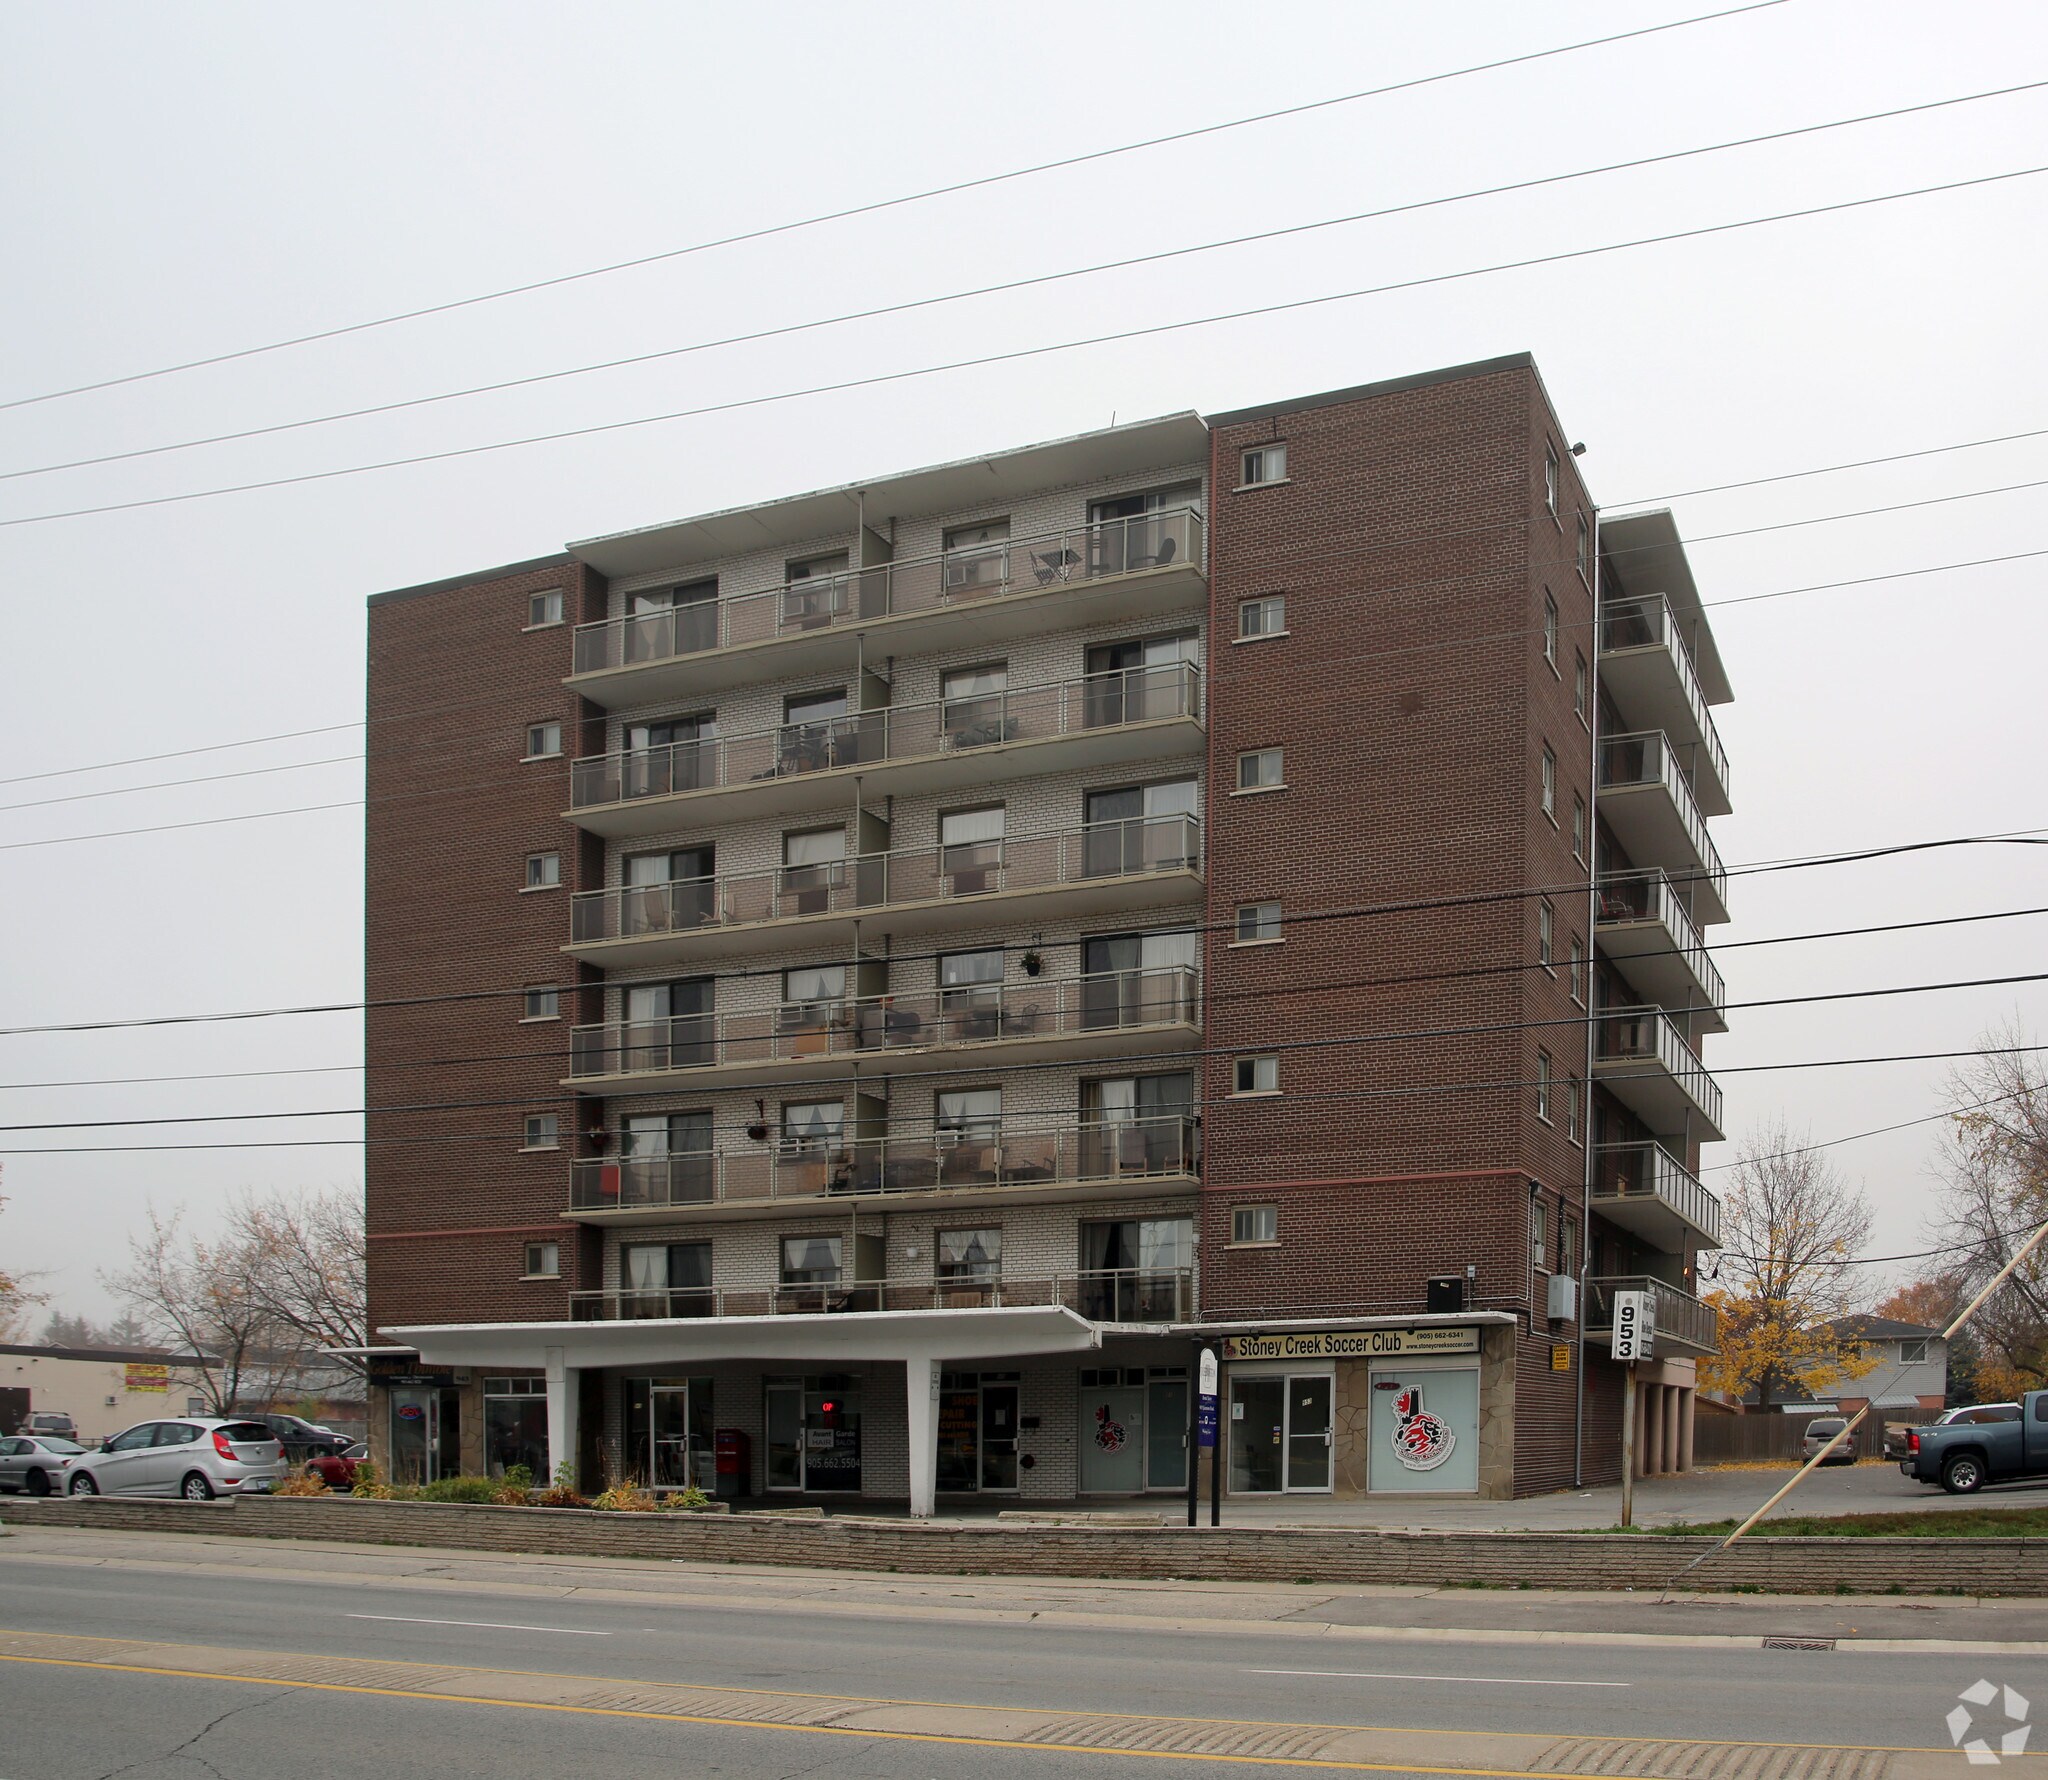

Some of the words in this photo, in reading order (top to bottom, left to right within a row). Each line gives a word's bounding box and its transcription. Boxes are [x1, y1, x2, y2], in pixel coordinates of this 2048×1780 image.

[1416, 1332, 1434, 1341] (905)
[1434, 1331, 1464, 1339] 662-6341
[1618, 1306, 1635, 1357] 953
[1239, 1338, 1282, 1356] Stoney
[1285, 1335, 1322, 1354] Creek
[1324, 1334, 1369, 1353] Soccer
[1372, 1332, 1402, 1352] Club
[1406, 1341, 1474, 1350] www.stoneycreeksoccer.com
[940, 1421, 977, 1429] CUTTING
[807, 1458, 860, 1469] 905.662.5504
